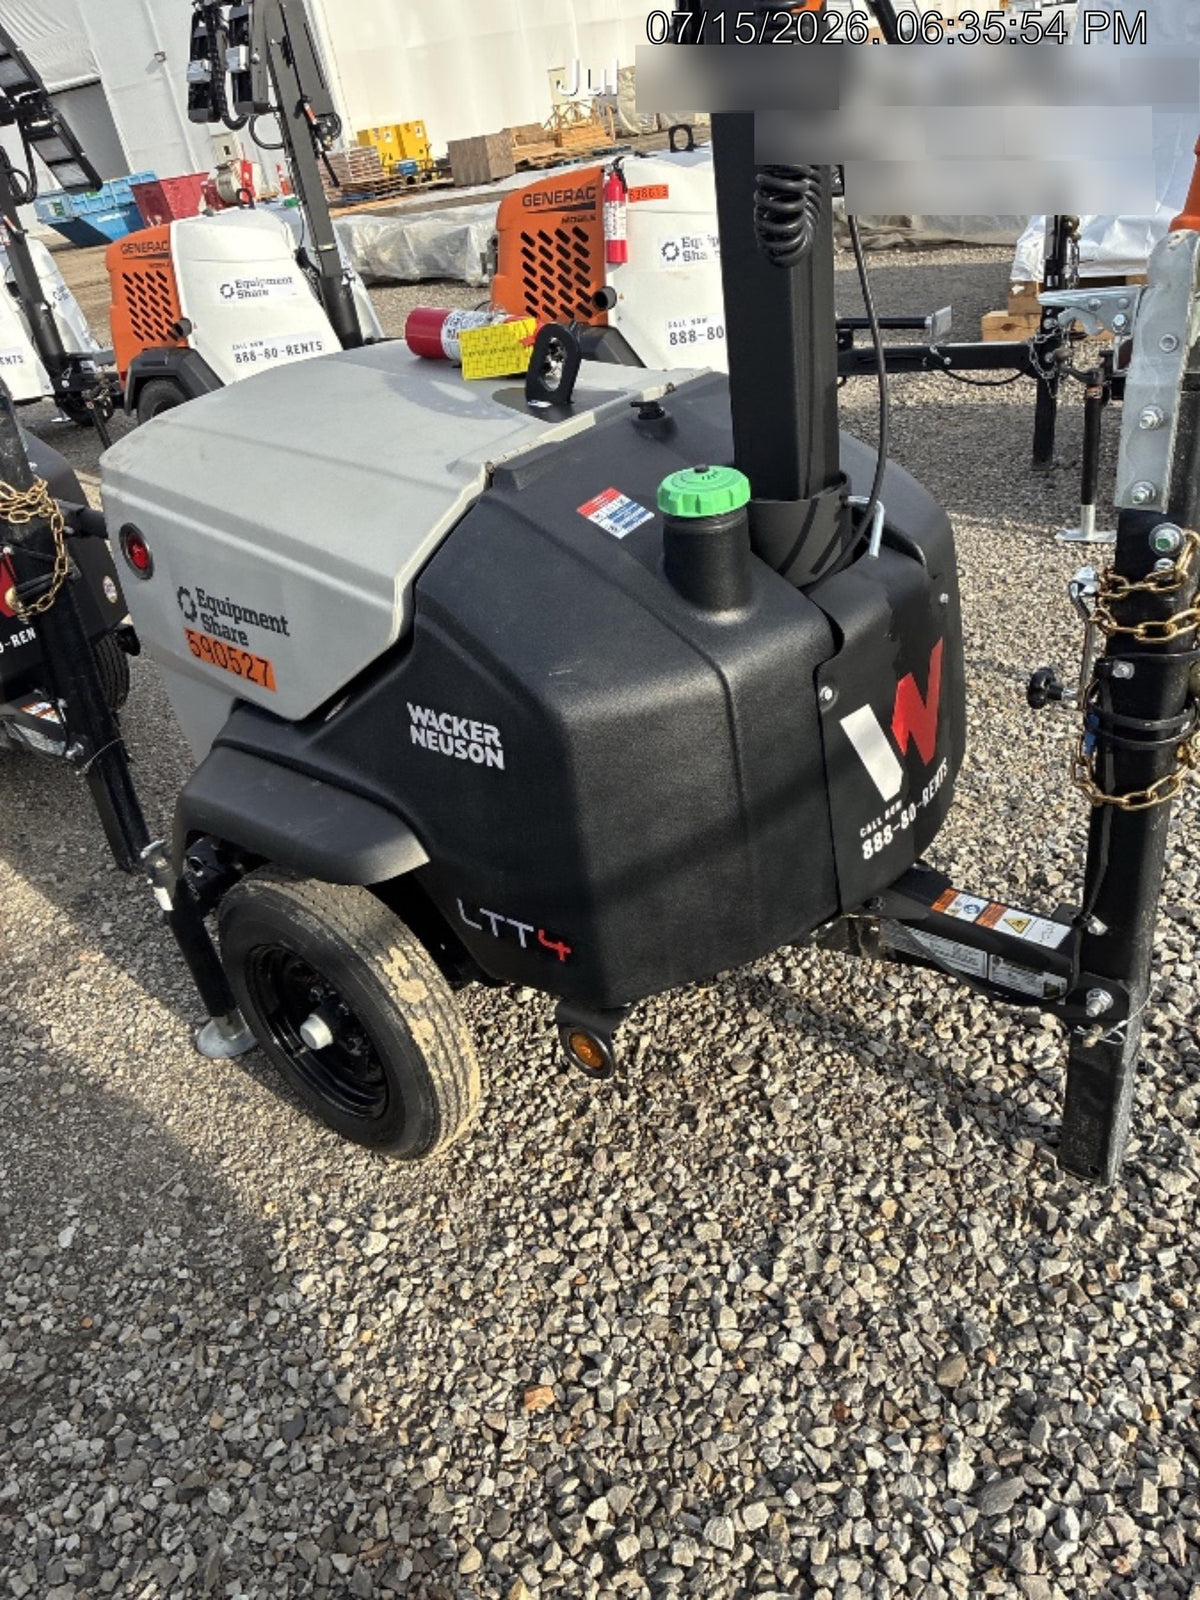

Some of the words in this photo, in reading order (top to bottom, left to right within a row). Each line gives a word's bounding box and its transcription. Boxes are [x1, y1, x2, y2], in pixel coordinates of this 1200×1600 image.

[522, 187, 596, 207] GENERAC
[121, 240, 169, 254] GENERAC
[195, 586, 290, 638] Equipment
[200, 612, 249, 647] Share
[184, 628, 268, 687] 590527
[406, 701, 503, 749] WACKER
[410, 724, 506, 771] NEUSON
[862, 756, 948, 860] 888-80-RENTS
[456, 897, 572, 963] LTT4
